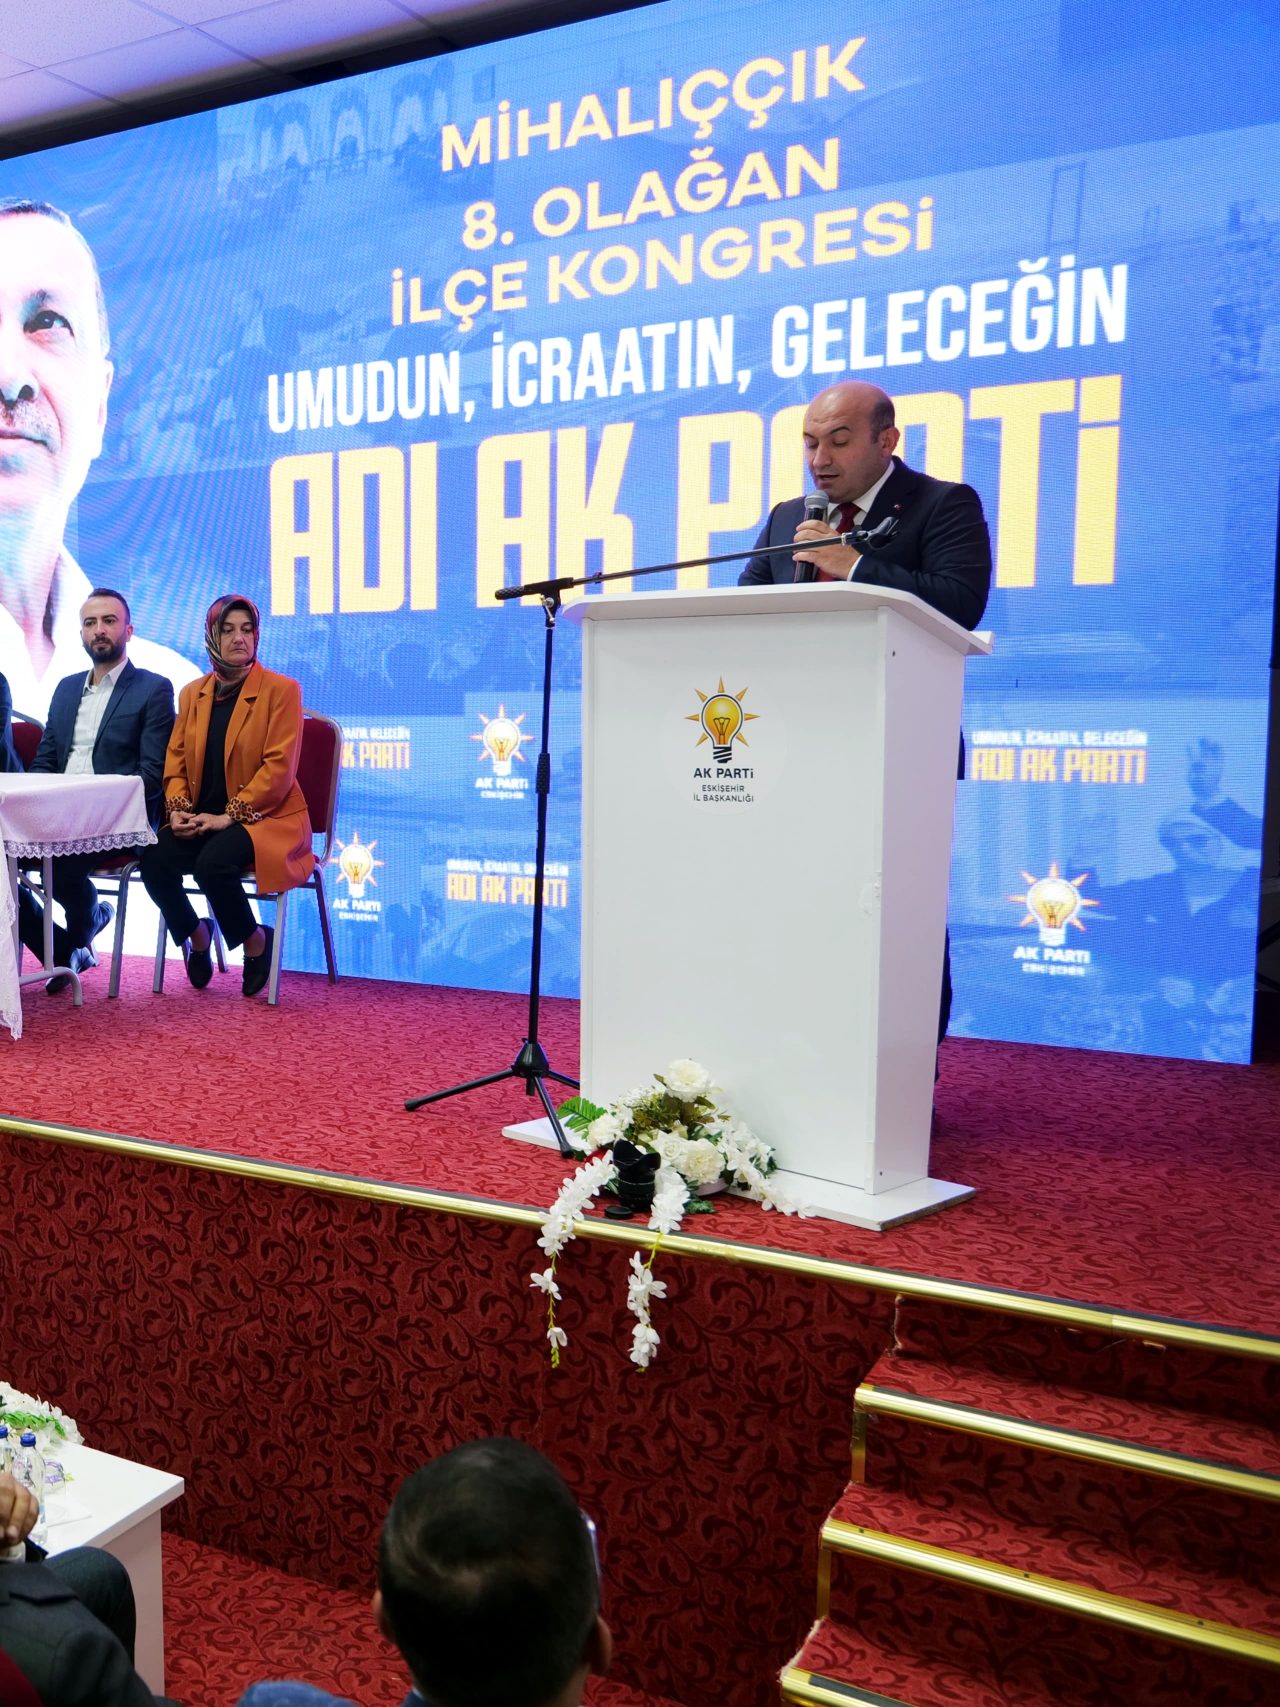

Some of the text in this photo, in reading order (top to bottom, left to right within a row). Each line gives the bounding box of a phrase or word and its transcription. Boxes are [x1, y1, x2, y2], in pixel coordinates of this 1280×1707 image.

[441, 37, 867, 172] MİHALIÇÇIK
[461, 137, 840, 250] 8. OLAĞAN
[391, 260, 528, 332] İLÇE
[267, 254, 1129, 434] UMUDUN, İCRAATIN, GELECEĞİN
[270, 441, 438, 616] ADI
[476, 421, 635, 608] AK
[693, 768, 712, 779] AK
[971, 748, 1015, 781] ADI
[1021, 748, 1057, 782] AK
[475, 777, 494, 789] AK
[693, 792, 754, 803] İL BAŞKANLIĞI
[701, 783, 745, 792] ESKİŞEHİR
[447, 873, 477, 901] ADI
[481, 875, 506, 903] AK
[332, 897, 349, 910] AK
[1013, 945, 1039, 960] AK
